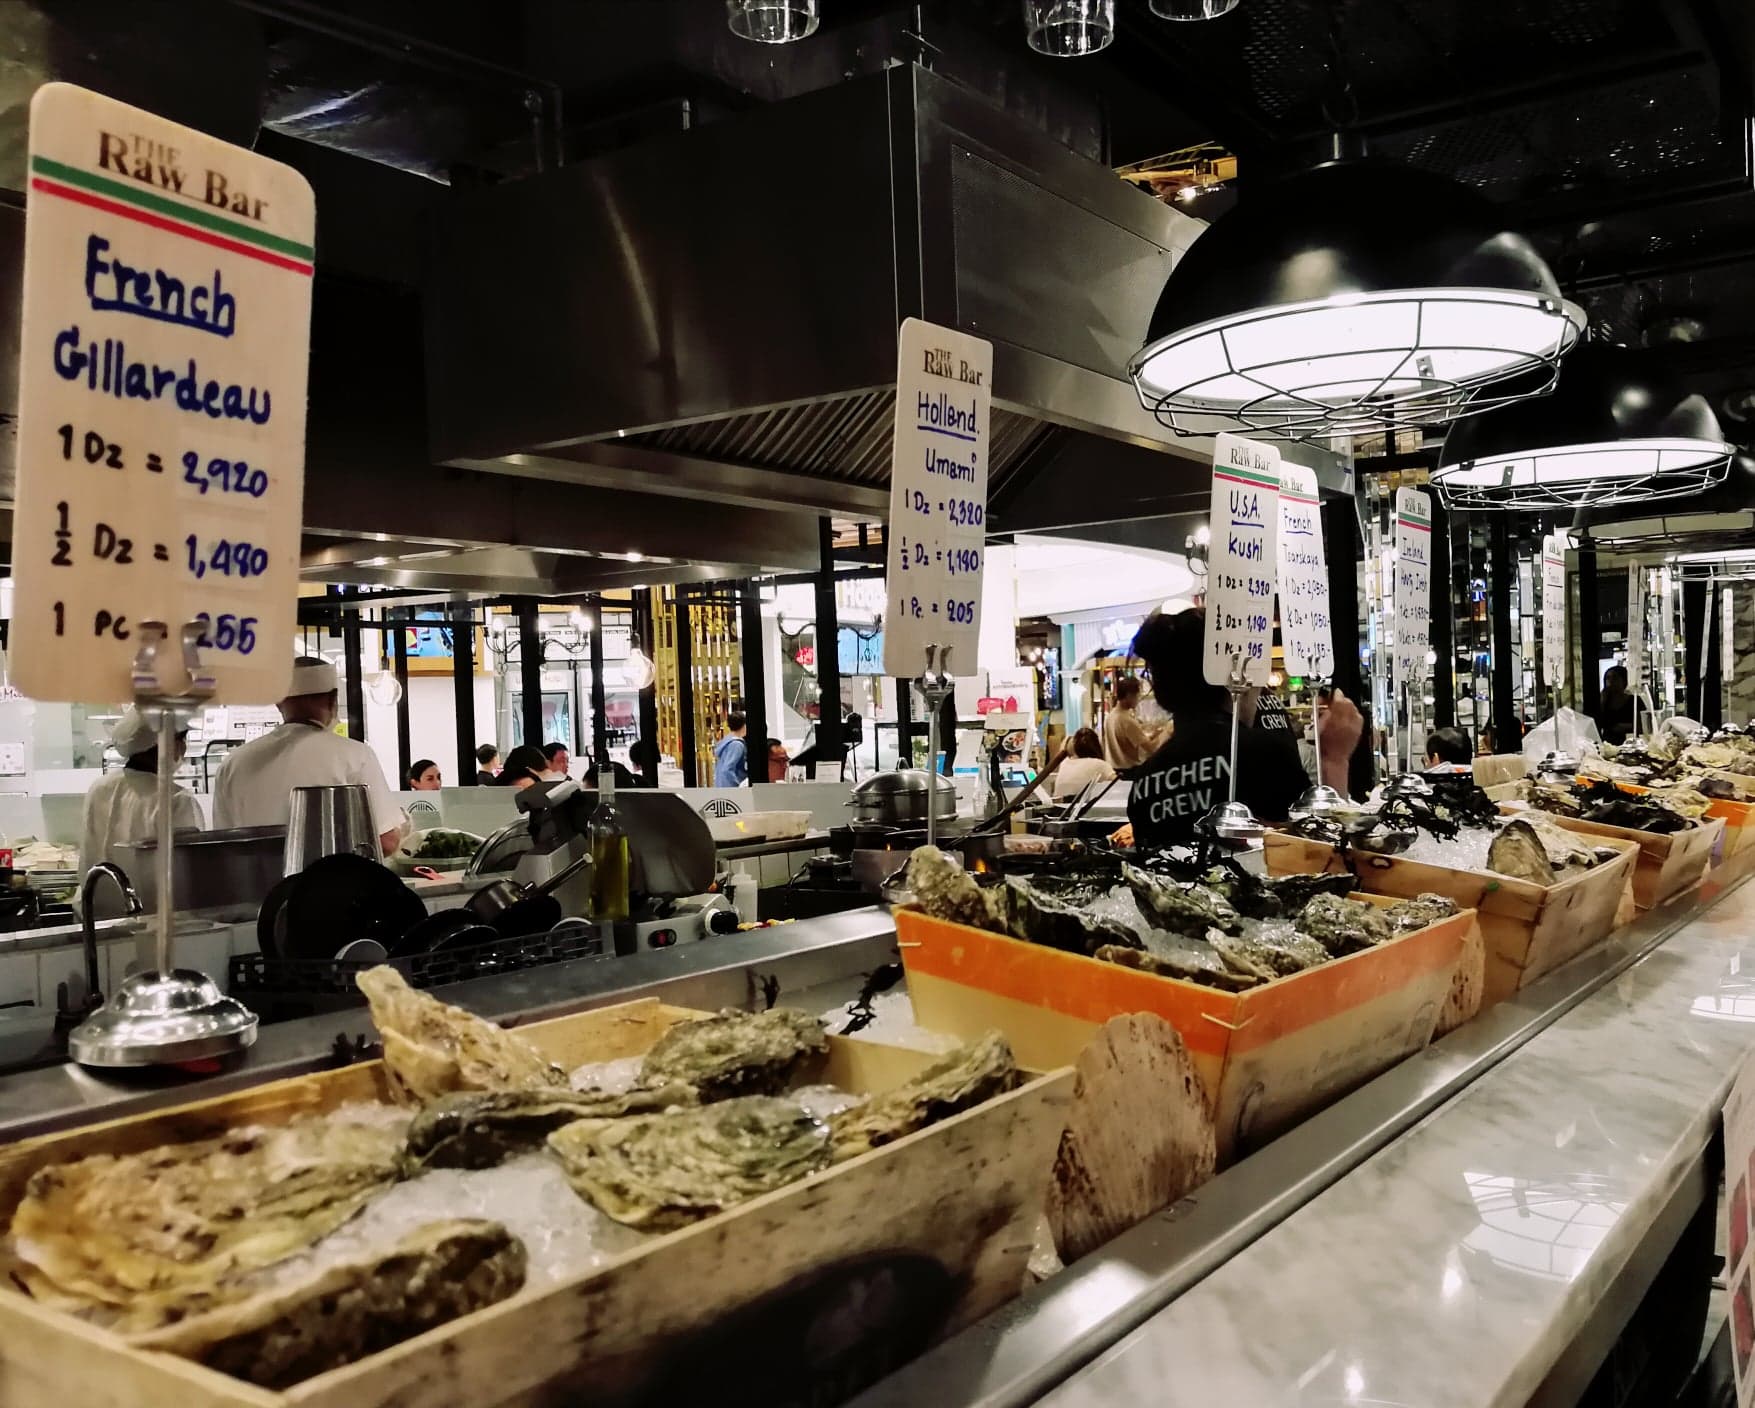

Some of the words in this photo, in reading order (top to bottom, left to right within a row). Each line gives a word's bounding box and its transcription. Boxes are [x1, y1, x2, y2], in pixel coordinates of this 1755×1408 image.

[130, 133, 181, 165] THE
[99, 130, 187, 194] Raw
[206, 169, 269, 221] Bar
[85, 234, 236, 331] French
[54, 325, 271, 424] Gillardeau
[923, 350, 953, 379] Raw
[959, 359, 983, 386] Bar
[58, 425, 74, 461] 1
[147, 454, 164, 473] =
[183, 451, 268, 498] 2,920
[925, 448, 977, 483] Umami
[1231, 448, 1250, 467] Raw
[1254, 455, 1270, 471] Bar
[949, 499, 983, 526] 2,320
[1230, 490, 1260, 519] U.S.A.
[1284, 506, 1312, 529] French
[154, 543, 170, 562] =
[54, 602, 65, 636] 1
[1261, 713, 1288, 730] CREW
[1132, 755, 1231, 804] KITCHEN
[1150, 788, 1212, 823] CREW
